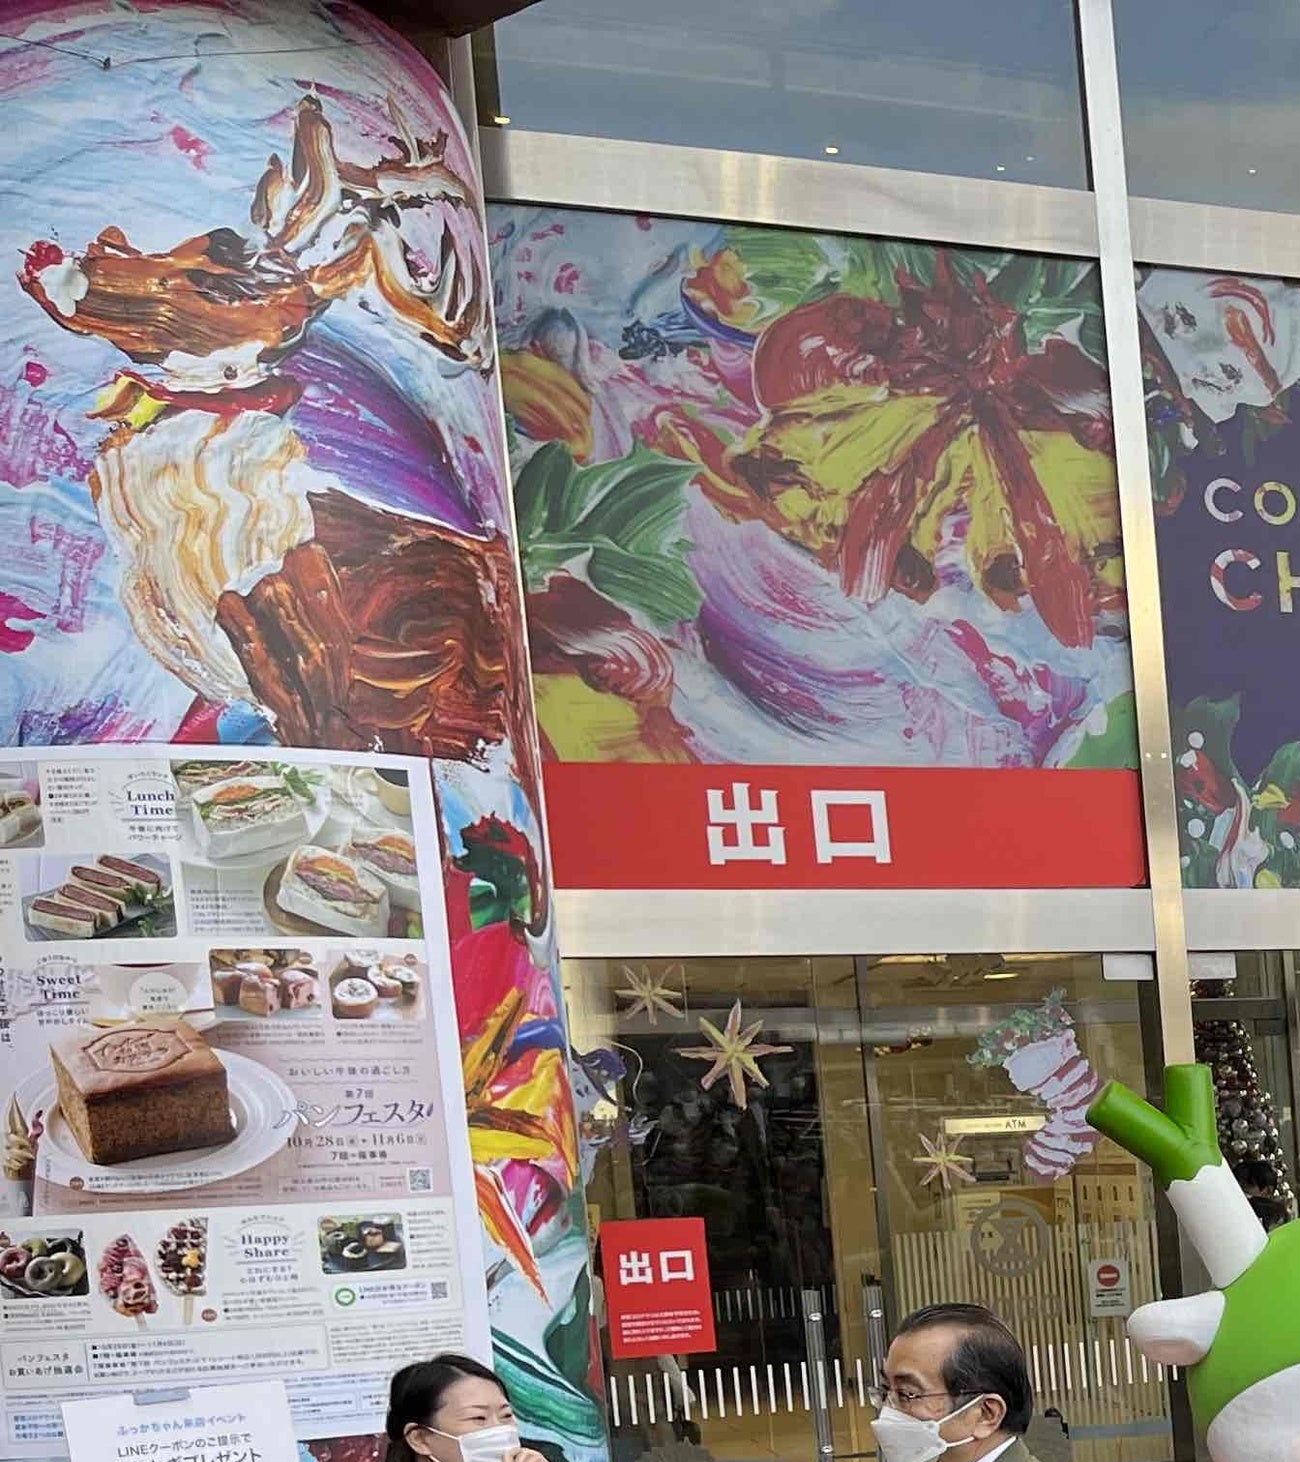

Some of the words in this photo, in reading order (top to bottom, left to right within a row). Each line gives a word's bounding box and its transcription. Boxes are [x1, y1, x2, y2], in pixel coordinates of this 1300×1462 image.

[127, 790, 175, 802] Lunch
[131, 804, 173, 816] Time
[706, 782, 893, 865] 出口
[36, 975, 81, 987] Sweet
[41, 988, 80, 1000] Time
[1005, 1119, 1027, 1129] ATM
[241, 1234, 289, 1246] Happy
[244, 1247, 290, 1258] Share
[619, 1249, 694, 1286] 出口
[118, 1433, 253, 1457] LINEクーポンのご提示で
